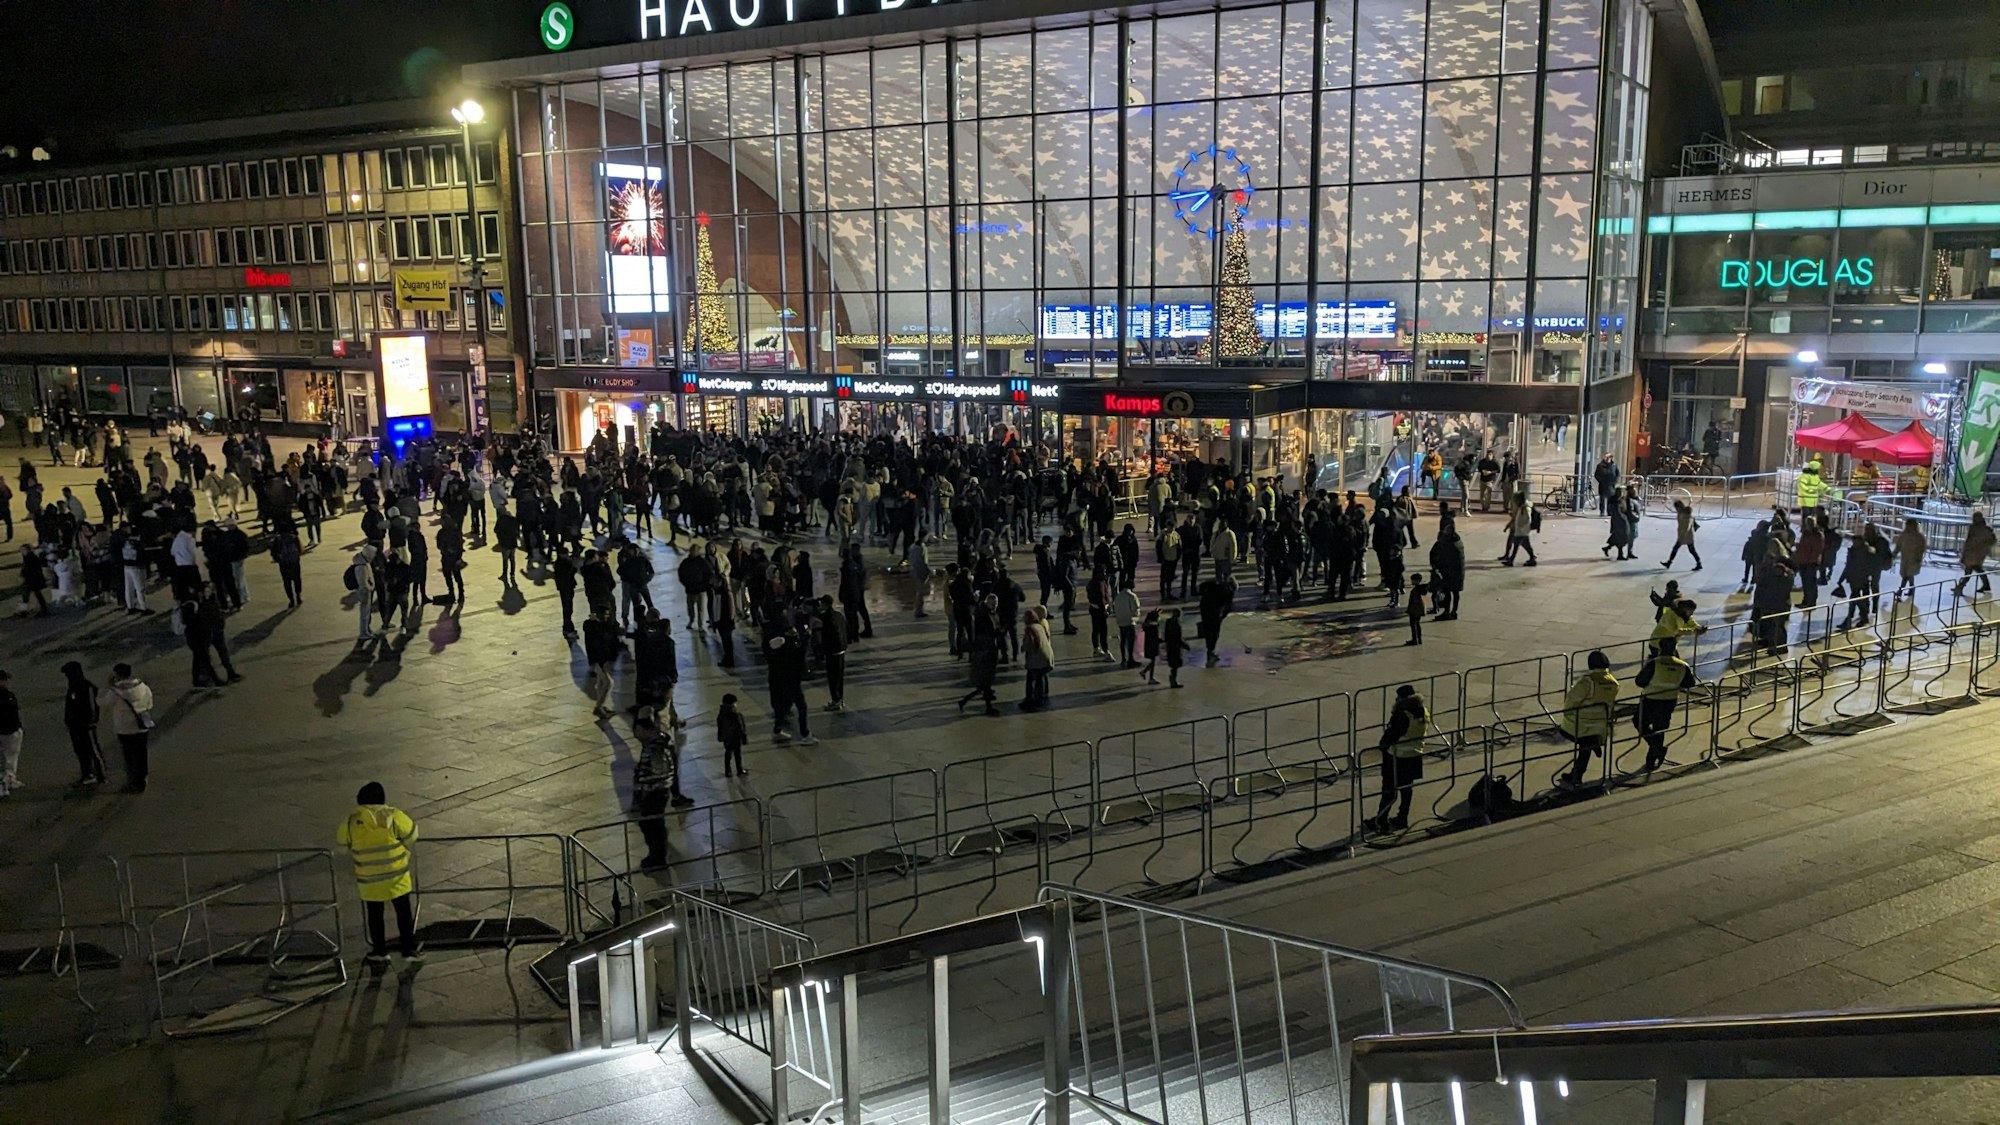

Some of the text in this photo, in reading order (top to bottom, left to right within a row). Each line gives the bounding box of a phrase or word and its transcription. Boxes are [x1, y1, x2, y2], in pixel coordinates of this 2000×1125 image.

[1864, 181, 1907, 196] Dior
[1721, 257, 1874, 288] DOUGLAS
[402, 279, 447, 292] Zugang Hbf
[1516, 317, 1586, 328] SARBUCK
[698, 377, 828, 394] NetCologne Highspeed
[854, 381, 1001, 398] NetCologne Highspeed
[1105, 394, 1161, 414] Kamps
